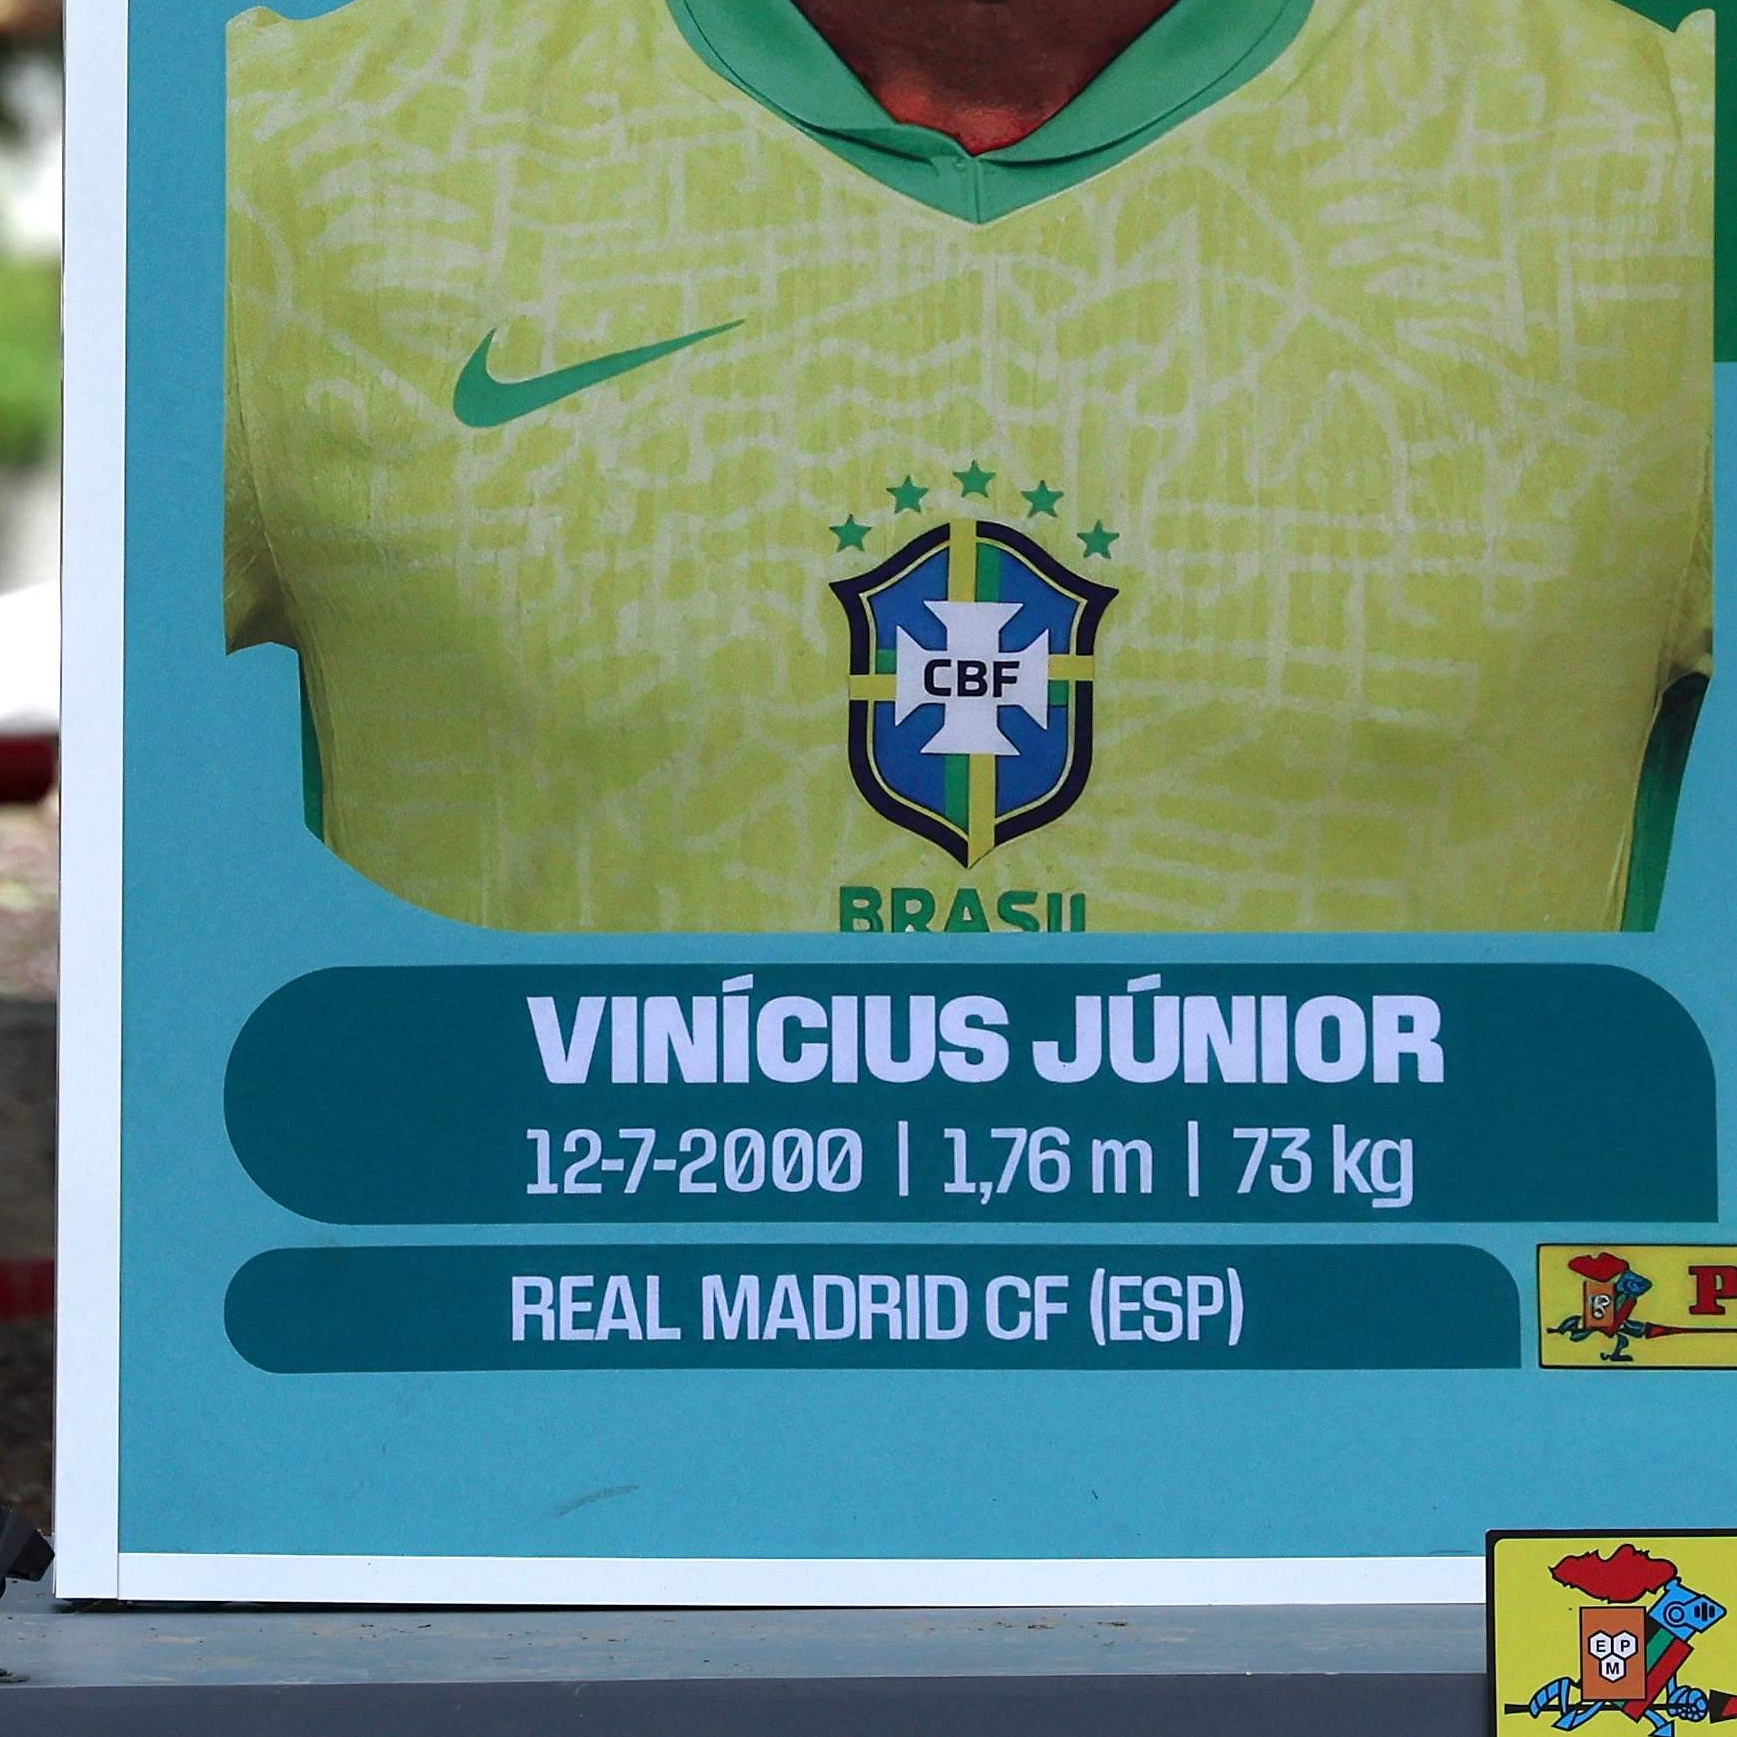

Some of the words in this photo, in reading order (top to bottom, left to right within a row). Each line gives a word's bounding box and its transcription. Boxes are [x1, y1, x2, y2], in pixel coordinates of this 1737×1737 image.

[923, 658, 1021, 698] CBF
[527, 974, 1010, 1084] VINÍCIUS
[1032, 974, 1445, 1084] JÚNIOR
[526, 1128, 863, 1195] 12-7-2000
[943, 1127, 1071, 1205] 1,76
[1092, 1139, 1153, 1193] m
[1233, 1127, 1312, 1193] 73
[1332, 1124, 1413, 1208] kg
[512, 1275, 681, 1341] REAL
[702, 1274, 968, 1340] MADRID
[986, 1275, 1068, 1340] CF
[1090, 1267, 1244, 1347] (ESP)
